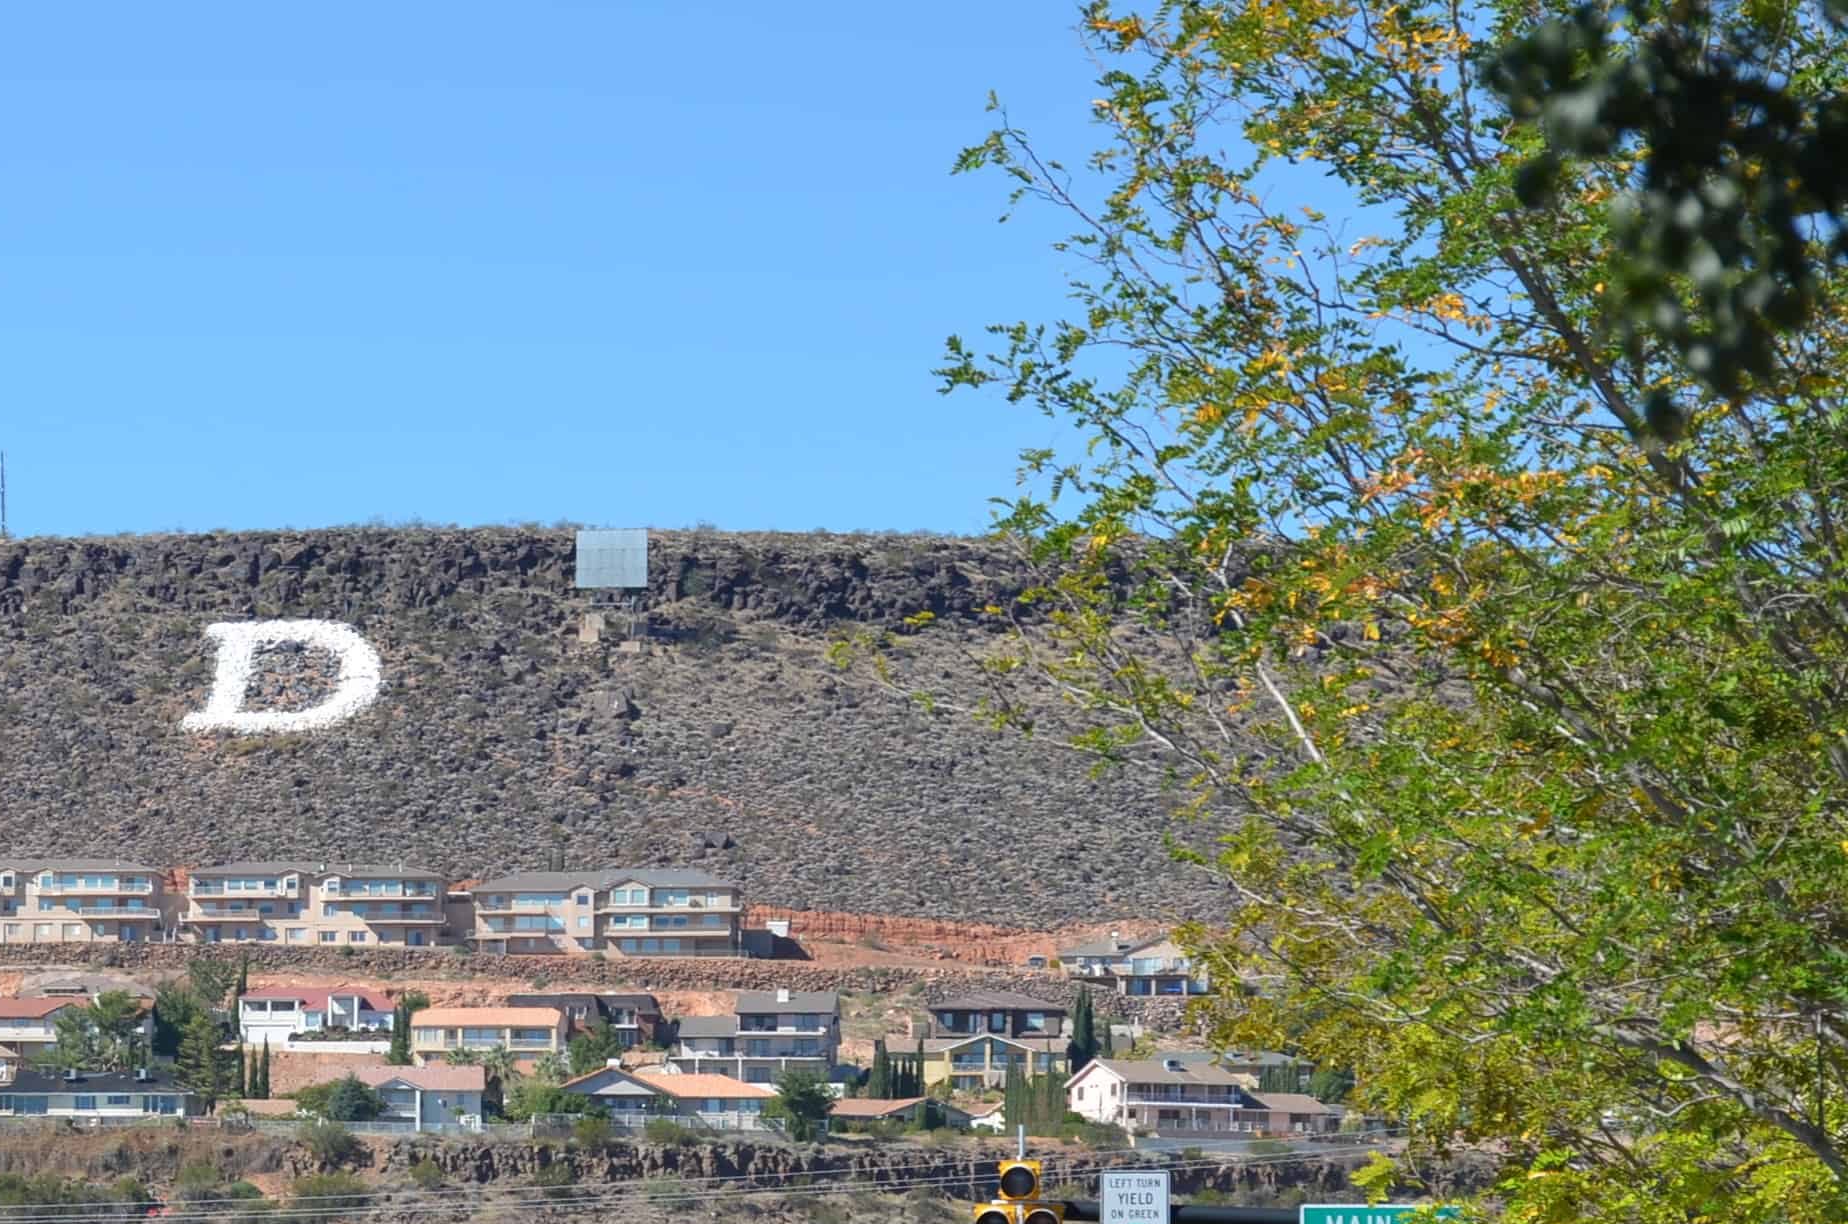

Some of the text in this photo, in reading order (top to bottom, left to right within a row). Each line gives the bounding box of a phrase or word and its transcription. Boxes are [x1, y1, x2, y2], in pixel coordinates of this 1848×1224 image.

[181, 619, 382, 734] D
[1110, 1178, 1161, 1188] LEFT TURN
[1118, 1192, 1154, 1205] YIELD
[1111, 1209, 1159, 1219] ON GREEN
